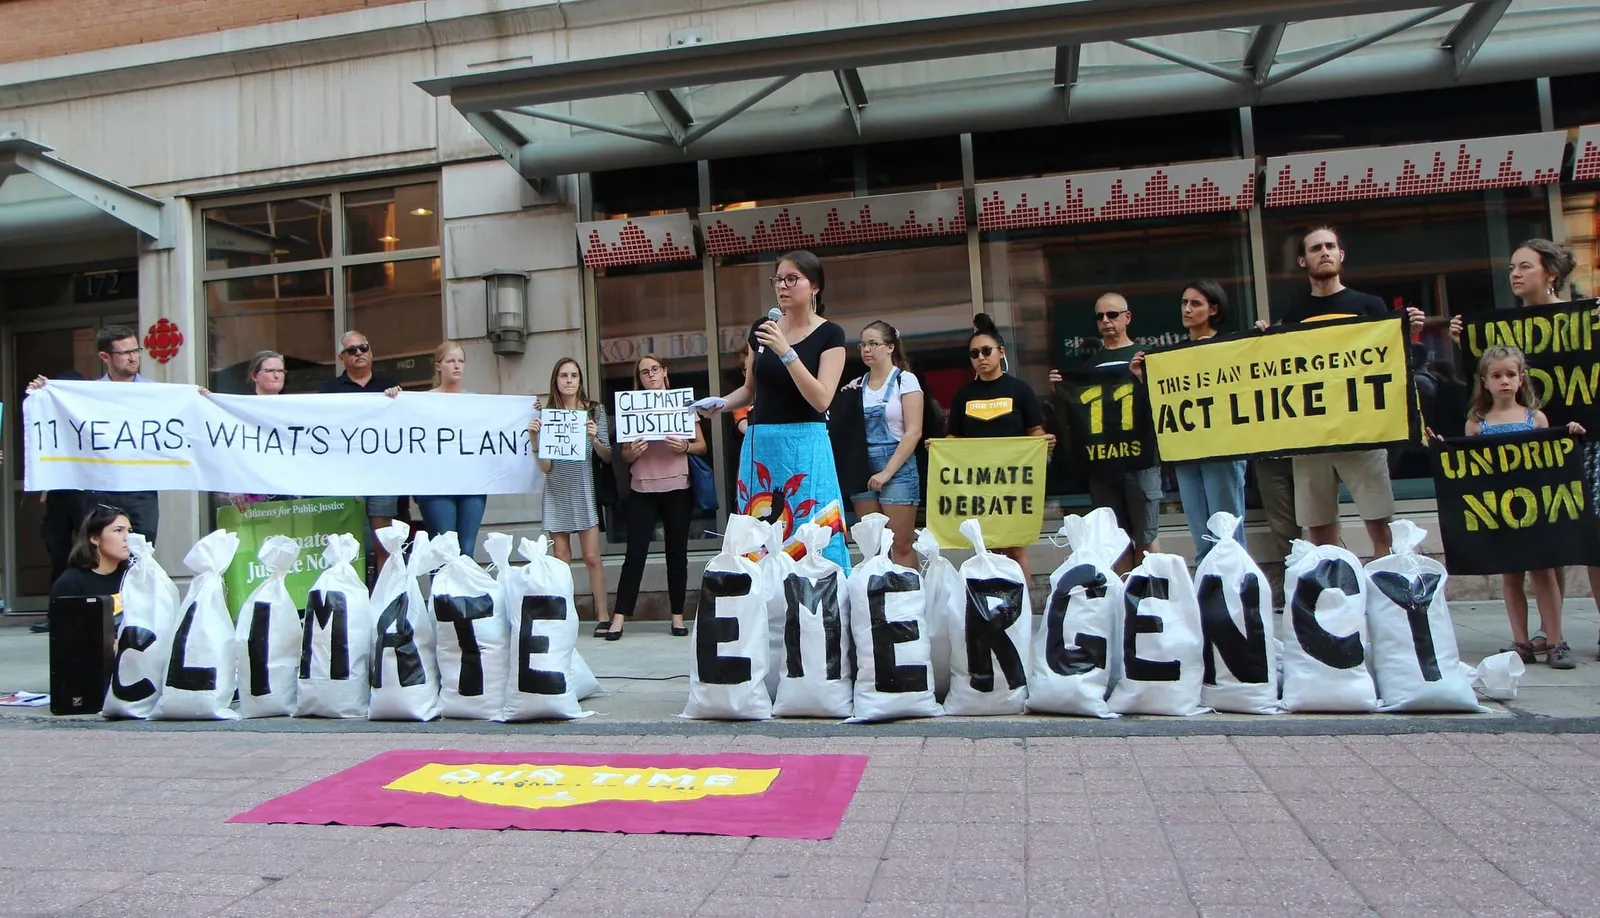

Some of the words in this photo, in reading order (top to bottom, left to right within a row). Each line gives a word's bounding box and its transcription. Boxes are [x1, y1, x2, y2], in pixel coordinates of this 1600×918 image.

[87, 273, 119, 297] 172
[1157, 375, 1191, 396] THIS
[1197, 370, 1210, 389] IS
[1216, 365, 1241, 385] AN
[1250, 346, 1388, 380] EMERGENCY
[1525, 362, 1600, 408] OW
[618, 390, 694, 412] CLIMATE
[969, 402, 987, 410] OUR
[988, 400, 1009, 408] TIME
[1079, 383, 1134, 435] 11
[1157, 396, 1214, 434] ACT
[1229, 381, 1326, 426] LIKE
[1346, 373, 1392, 412] IT
[549, 410, 578, 422] IT'S
[620, 412, 693, 436] JUSTICE
[33, 420, 58, 451] 11
[68, 418, 192, 451] YEARS.
[205, 421, 330, 456] WHAT'S
[340, 426, 427, 455] YOUR
[437, 427, 531, 456] PLAN?
[544, 422, 580, 434] TIME
[545, 444, 580, 457] TALK
[554, 435, 570, 445] TO
[1086, 440, 1142, 462] YEARS
[1440, 437, 1574, 480] UNDRIP
[939, 465, 1034, 486] CLIMATE
[244, 508, 277, 518] Citizens
[276, 505, 291, 518] for
[292, 503, 318, 514] Public
[318, 501, 345, 513] Justice
[938, 495, 1034, 516] DEBATE
[1463, 480, 1585, 531] NOW
[306, 553, 329, 571] No
[112, 589, 567, 702] CLIMATE
[696, 558, 1441, 692] EMERGENCY
[440, 768, 565, 784] OUR
[590, 772, 738, 787] TIME
